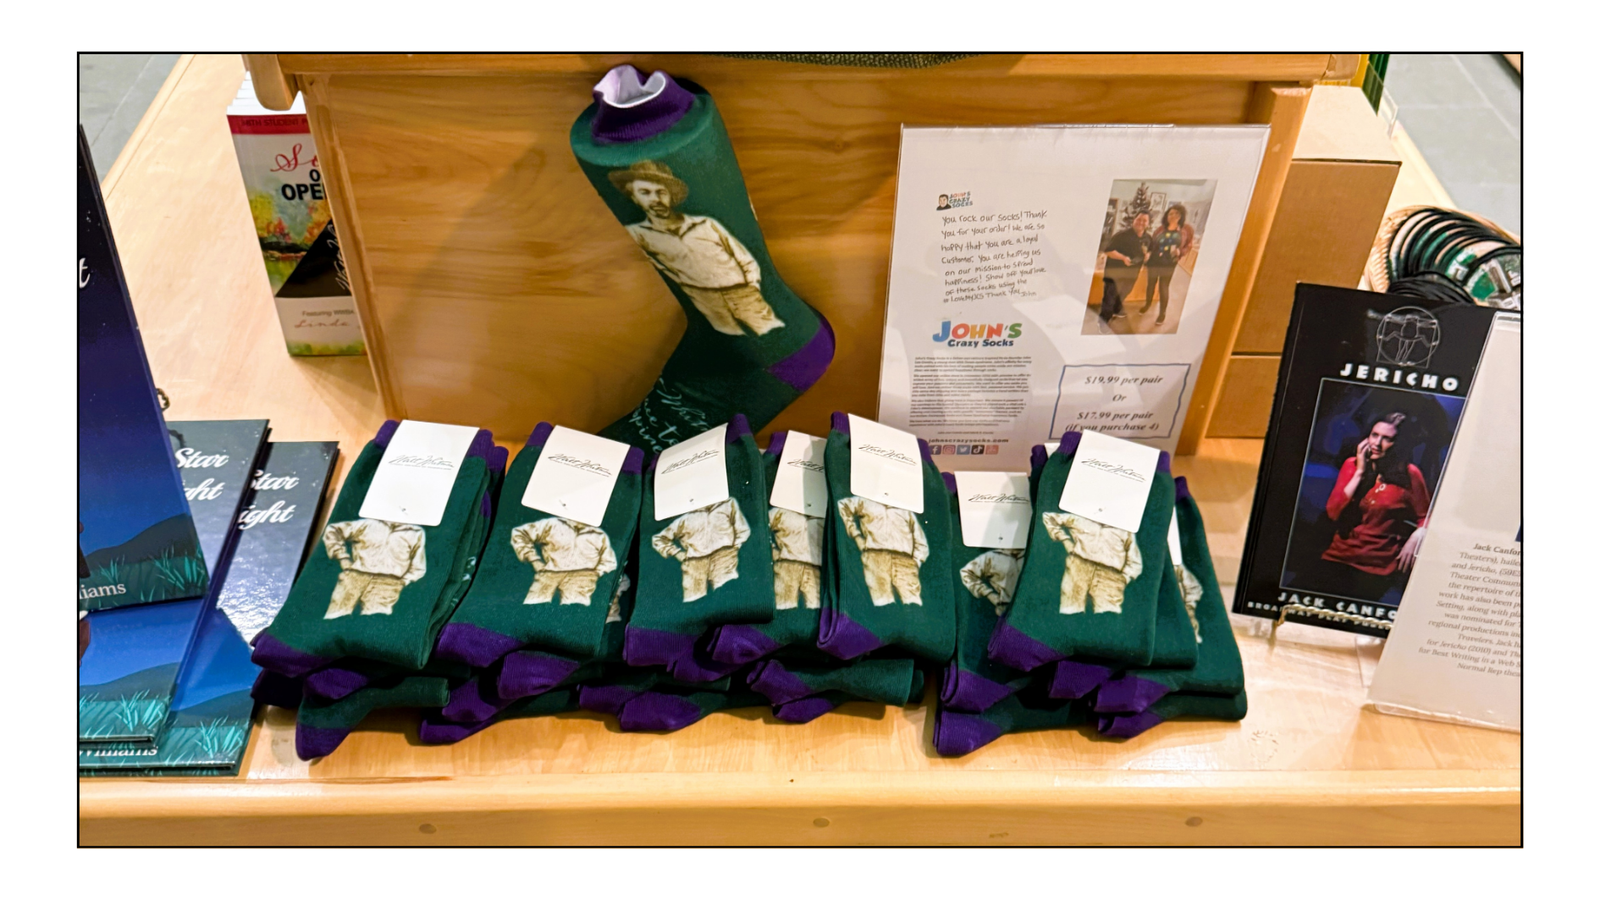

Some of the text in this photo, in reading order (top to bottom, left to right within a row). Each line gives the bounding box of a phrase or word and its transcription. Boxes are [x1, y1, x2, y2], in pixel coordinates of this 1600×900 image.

[980, 214, 995, 222] our
[1024, 210, 1047, 219] Thank
[965, 242, 983, 251] that
[932, 321, 1022, 342] JOHN'S
[948, 339, 1014, 348] Crazy Socks
[1085, 376, 1163, 385] $19.99 per pair
[1340, 362, 1459, 391] JERICHO
[1112, 394, 1127, 402] Or
[1077, 412, 1111, 420] $17.99
[1131, 412, 1154, 420] pair
[1099, 424, 1146, 432] purchase
[175, 447, 229, 468] Star
[182, 478, 225, 501] ght
[1450, 572, 1481, 581] Theater
[1463, 585, 1503, 595] repertoire
[1278, 592, 1325, 608] JACK
[1439, 591, 1458, 599] work
[1476, 596, 1491, 604] also
[1493, 598, 1512, 607] been
[1467, 605, 1489, 614] along
[1491, 608, 1508, 617] with
[1461, 615, 1502, 625] nominated
[1504, 619, 1516, 627] for
[1428, 620, 1460, 630] regional
[1461, 625, 1508, 637] productions
[1496, 638, 1513, 647] Jack
[1440, 641, 1467, 650] Jericho
[1468, 645, 1491, 655] (2010)
[1493, 649, 1507, 657] and
[1432, 649, 1448, 657] Best
[1451, 651, 1480, 663] Writing
[1498, 658, 1515, 667] Web
[1457, 663, 1486, 672] Normal
[1487, 666, 1502, 676] Rep
